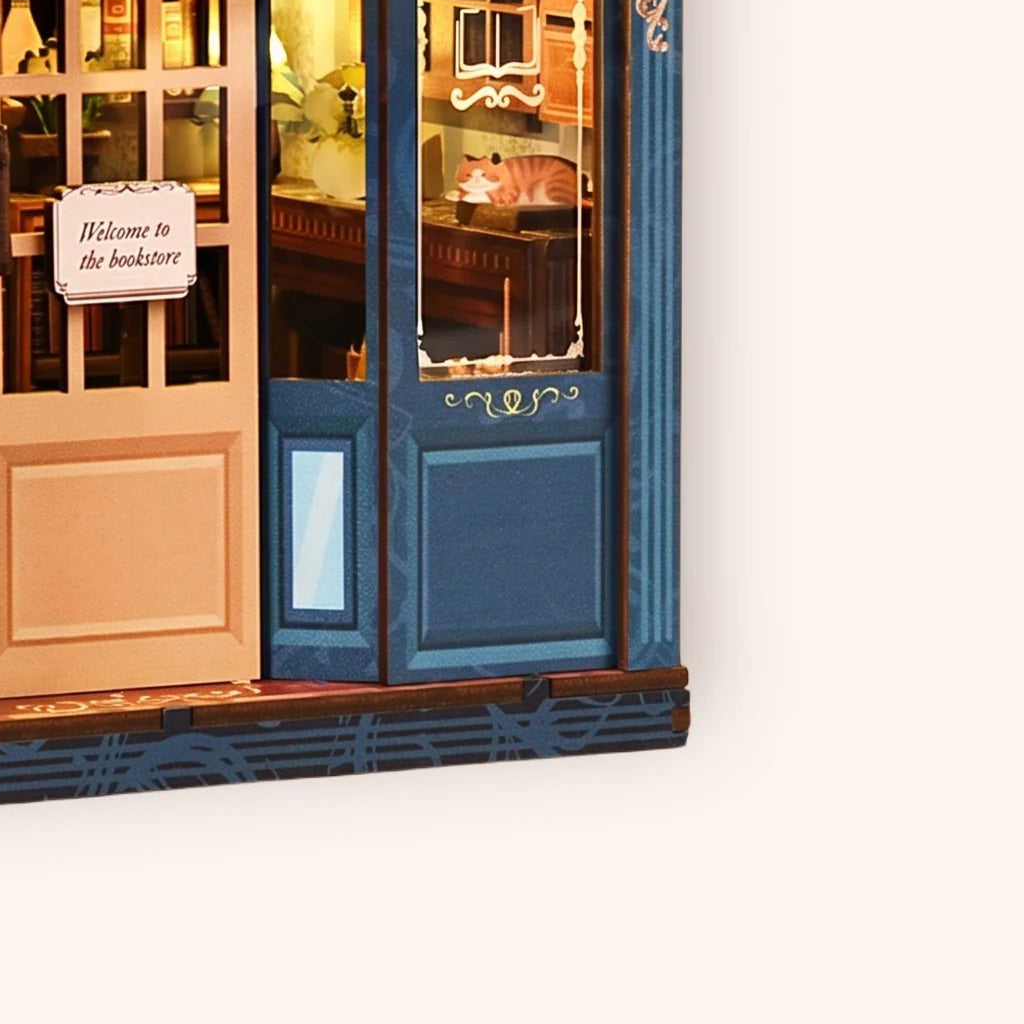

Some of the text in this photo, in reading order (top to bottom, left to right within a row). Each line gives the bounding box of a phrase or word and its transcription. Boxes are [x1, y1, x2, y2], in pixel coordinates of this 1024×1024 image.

[79, 221, 171, 243] Welcome to
[79, 246, 182, 271] the bookstore
